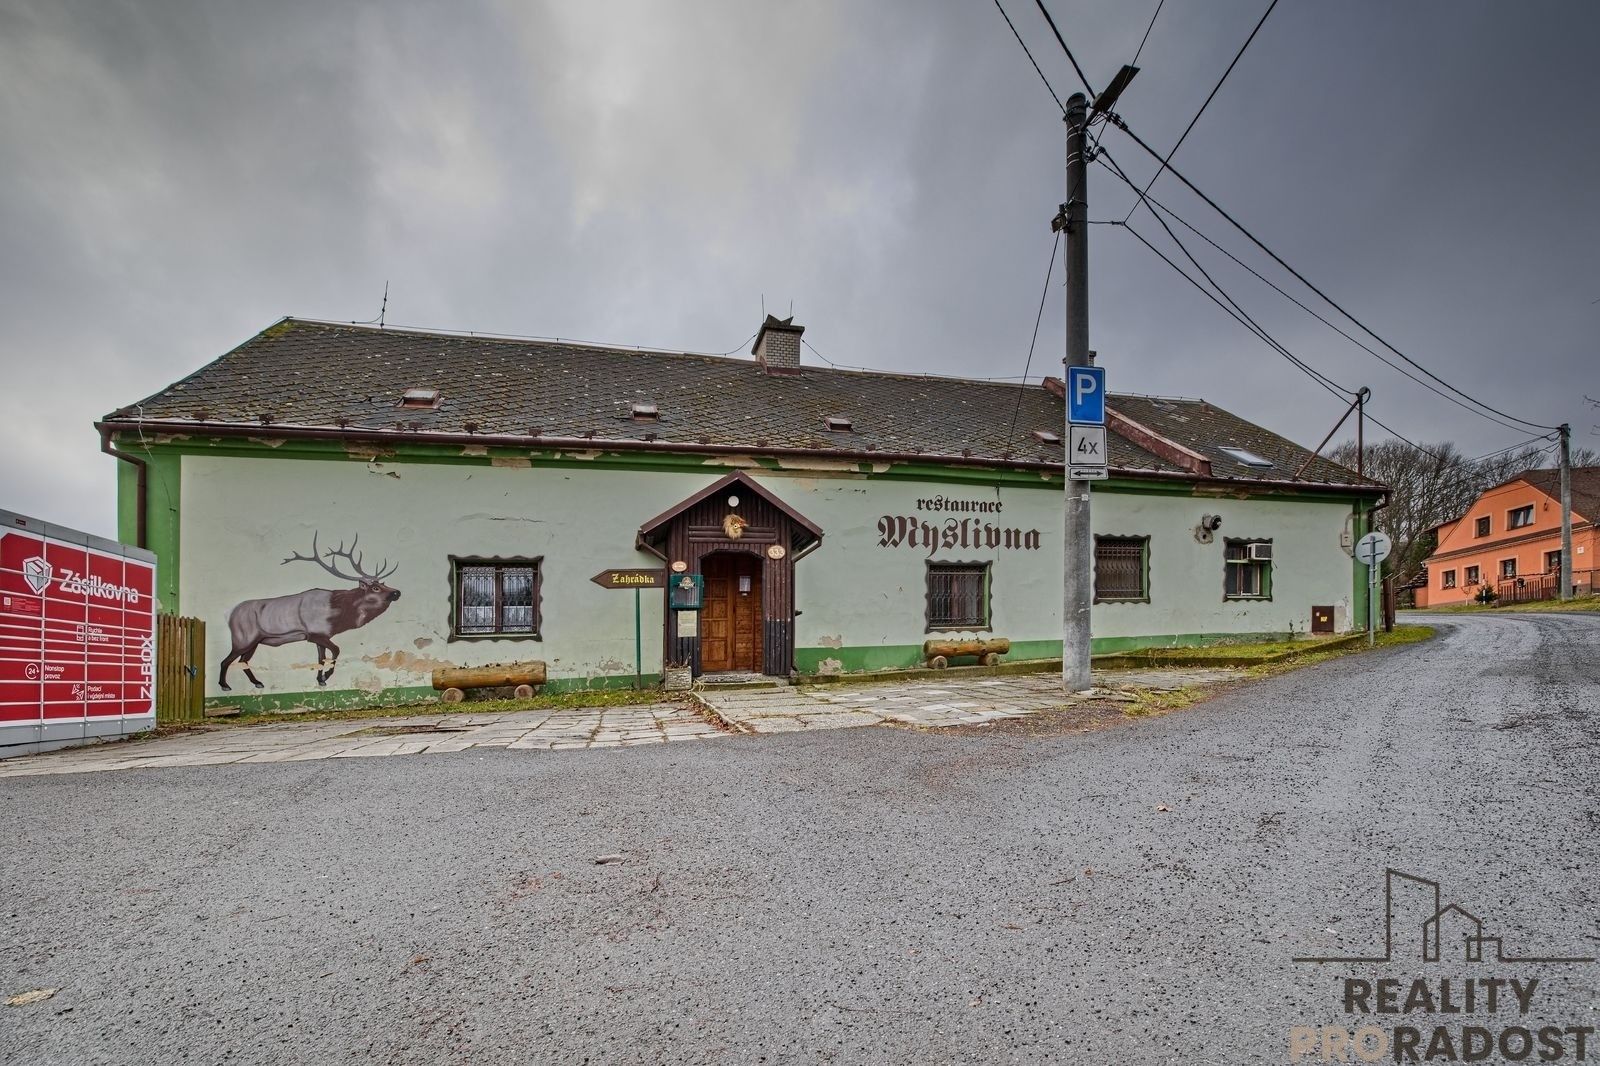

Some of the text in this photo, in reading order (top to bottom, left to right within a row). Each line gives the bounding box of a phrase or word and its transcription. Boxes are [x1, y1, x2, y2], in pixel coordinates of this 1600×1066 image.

[1076, 373, 1097, 406] P
[1077, 436, 1099, 455] 4x
[916, 494, 1004, 514] restaurace
[876, 515, 1041, 559] Myslivna
[59, 568, 139, 604] Zásilkovna
[611, 573, 655, 584] Zahrádka
[44, 665, 64, 673] Nonstop
[140, 634, 153, 699] Z-BOX
